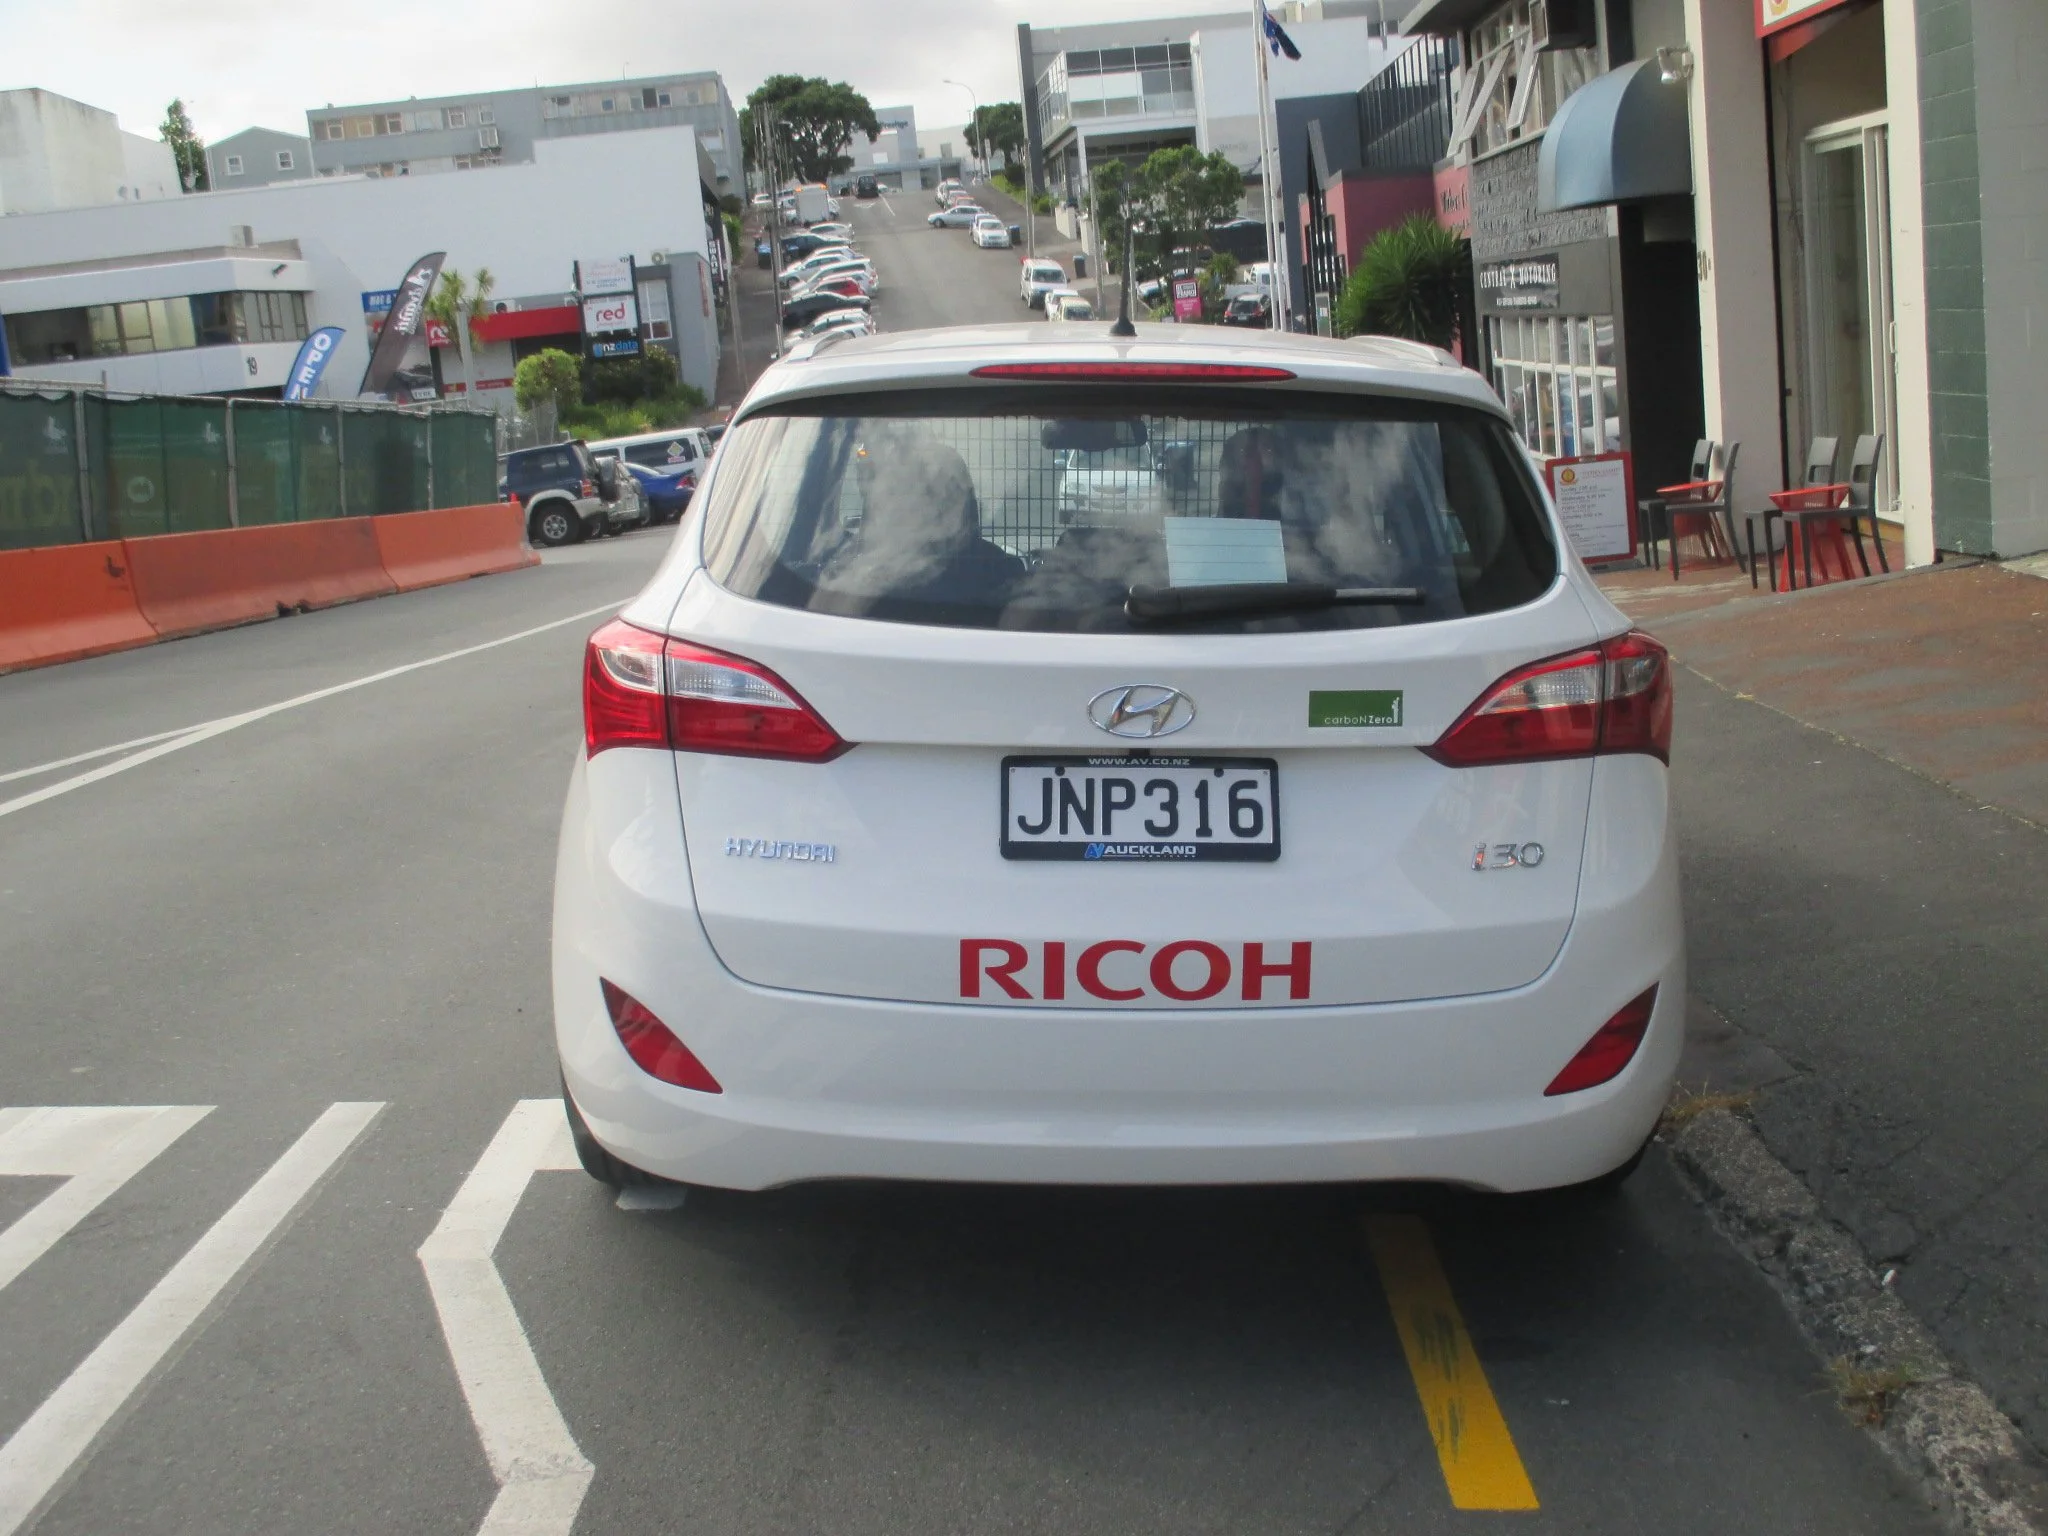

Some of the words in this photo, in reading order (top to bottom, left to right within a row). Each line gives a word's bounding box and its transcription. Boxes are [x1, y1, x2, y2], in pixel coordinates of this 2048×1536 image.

[1519, 263, 1556, 286] MOTORING
[596, 302, 625, 322] red
[290, 333, 332, 400] OPEN
[1088, 758, 1190, 766] WWW.AV.CO.NZ
[1017, 777, 1264, 839] JNP316
[726, 837, 836, 862] HYUNDAI
[1104, 845, 1197, 855] AUCKLAND
[1471, 842, 1545, 871] i30
[960, 938, 1312, 1001] RICOH
